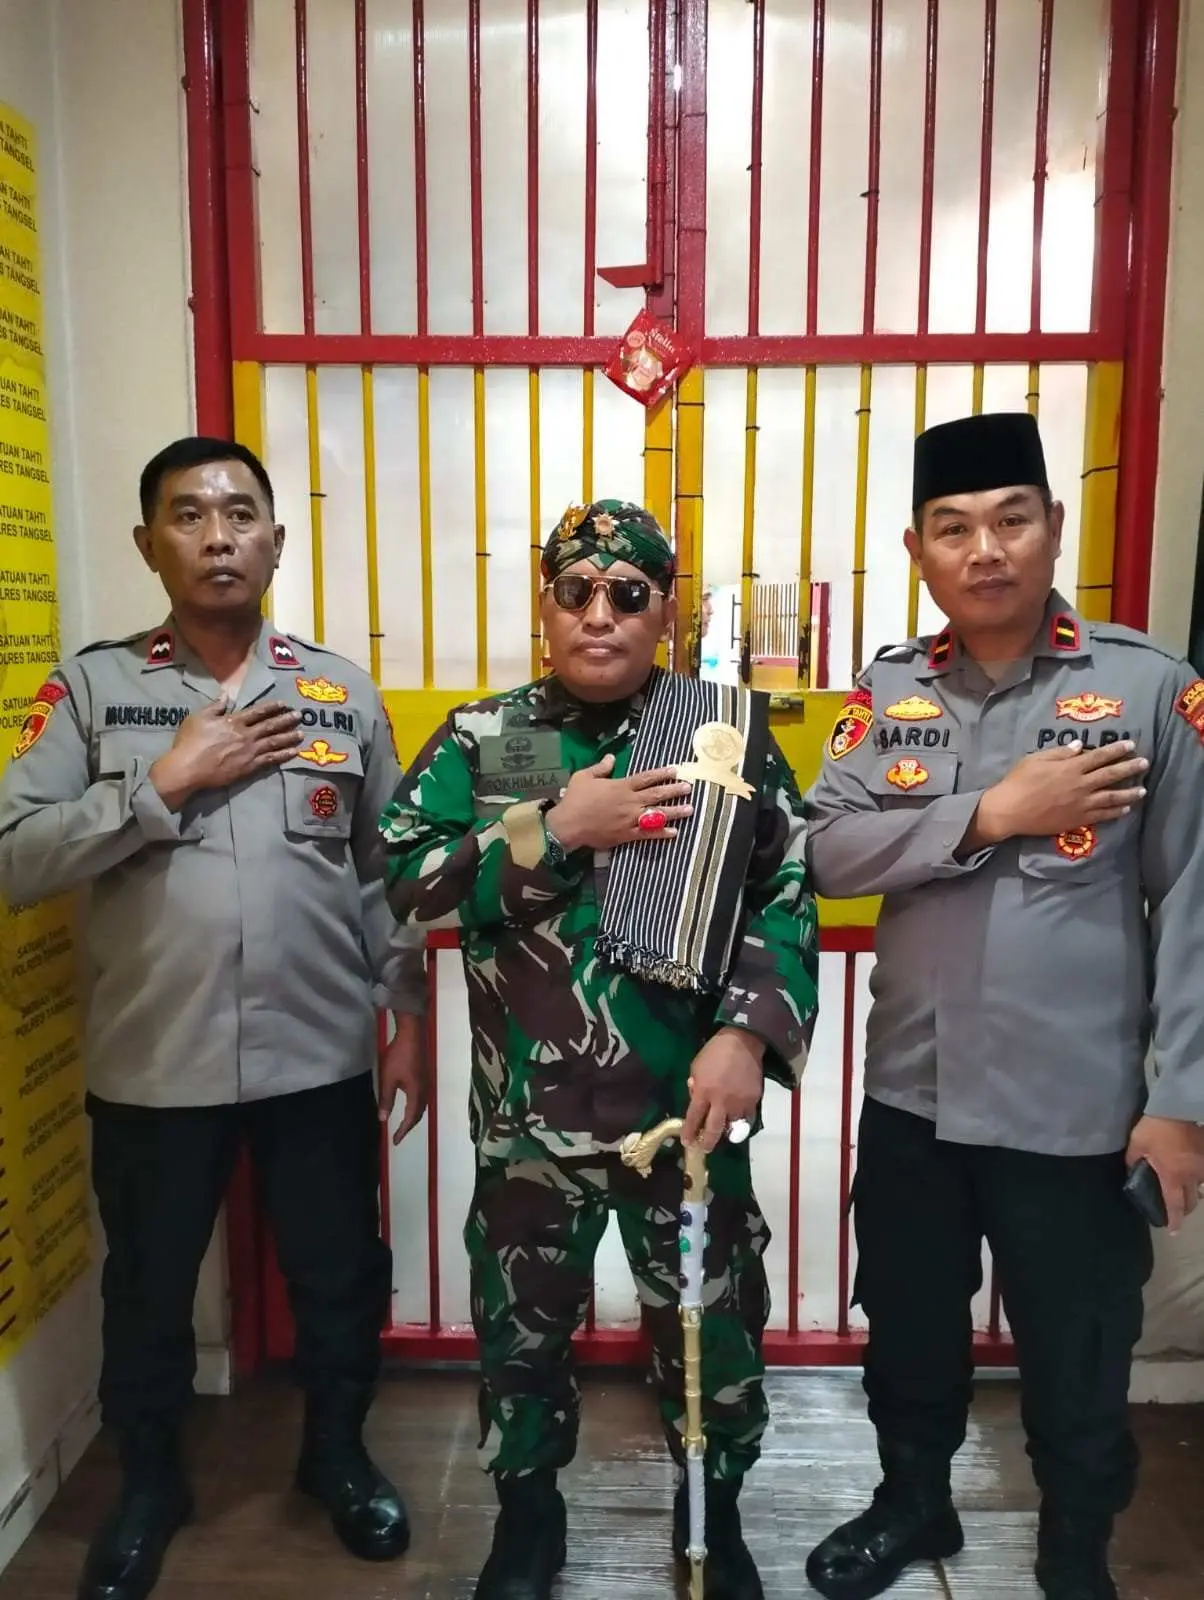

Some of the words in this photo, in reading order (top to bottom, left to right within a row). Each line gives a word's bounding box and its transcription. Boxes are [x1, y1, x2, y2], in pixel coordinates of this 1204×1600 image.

[3, 199, 38, 233] TANGSEL
[5, 265, 41, 295] TANGSEL
[8, 329, 44, 356] TANGSEL
[18, 383, 40, 402] TAHTI
[12, 398, 47, 422] TANGSEL
[21, 447, 43, 466] TAHTI
[15, 463, 51, 484] TANGSEL
[25, 509, 47, 525] TAHTI
[19, 525, 55, 543] TANGSEL
[28, 572, 50, 586] TAHTI
[22, 588, 58, 603] TANGSEL
[31, 633, 54, 648] TAHTI
[26, 650, 60, 664] TANGSEL
[2, 696, 34, 712] SATUAN
[0, 714, 26, 729] OLRE
[299, 707, 354, 733] OLRI
